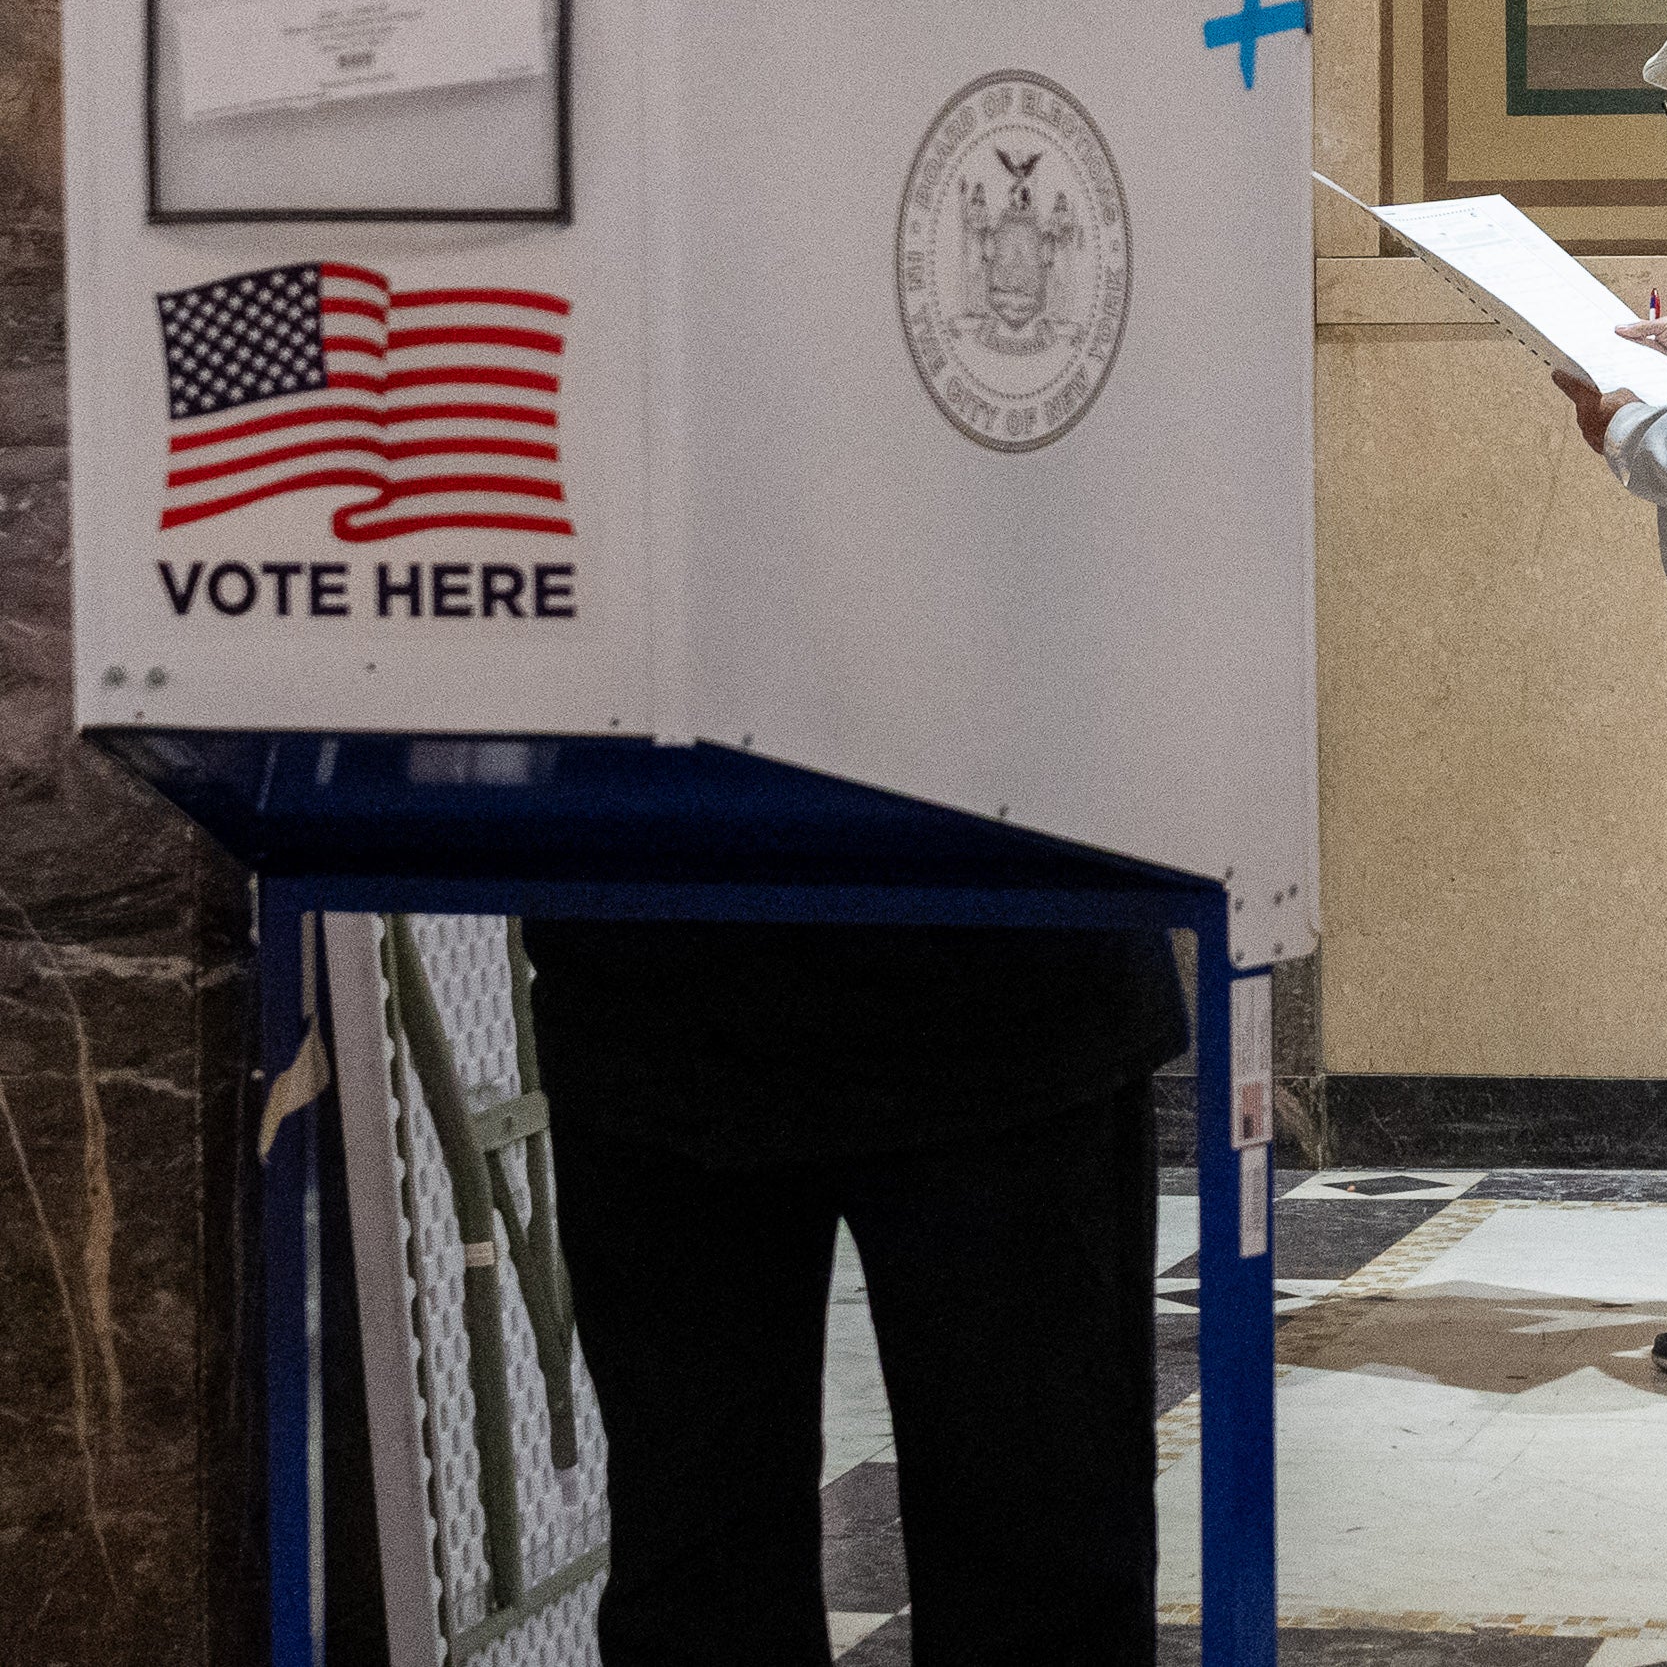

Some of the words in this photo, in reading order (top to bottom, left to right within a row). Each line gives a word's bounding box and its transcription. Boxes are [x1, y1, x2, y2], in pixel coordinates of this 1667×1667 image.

[981, 86, 1014, 120] OF
[1005, 405, 1038, 436] OF
[157, 560, 350, 617] VOTE
[377, 561, 578, 618] HERE
